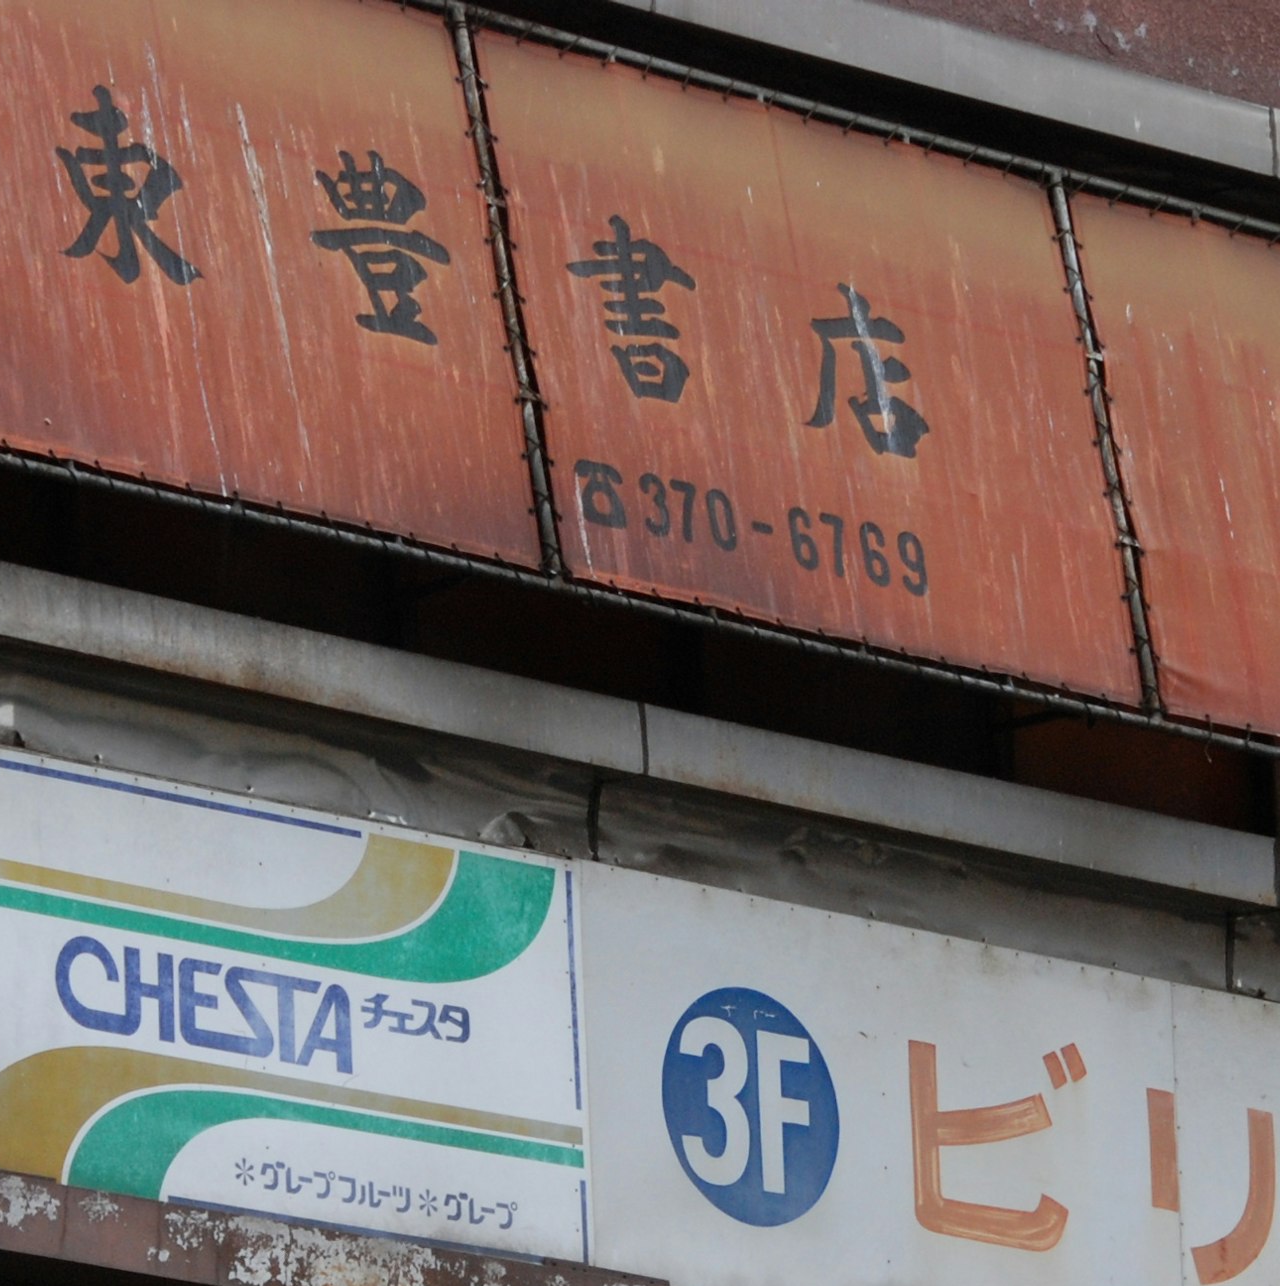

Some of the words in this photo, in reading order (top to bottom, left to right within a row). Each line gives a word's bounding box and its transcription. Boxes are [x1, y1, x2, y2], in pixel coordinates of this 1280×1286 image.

[54, 84, 931, 458] 東豊書店
[639, 472, 929, 598] 370-6769
[54, 935, 354, 1075] CHESTA
[359, 992, 471, 1045] チェスタ
[679, 1015, 811, 1195] 3F
